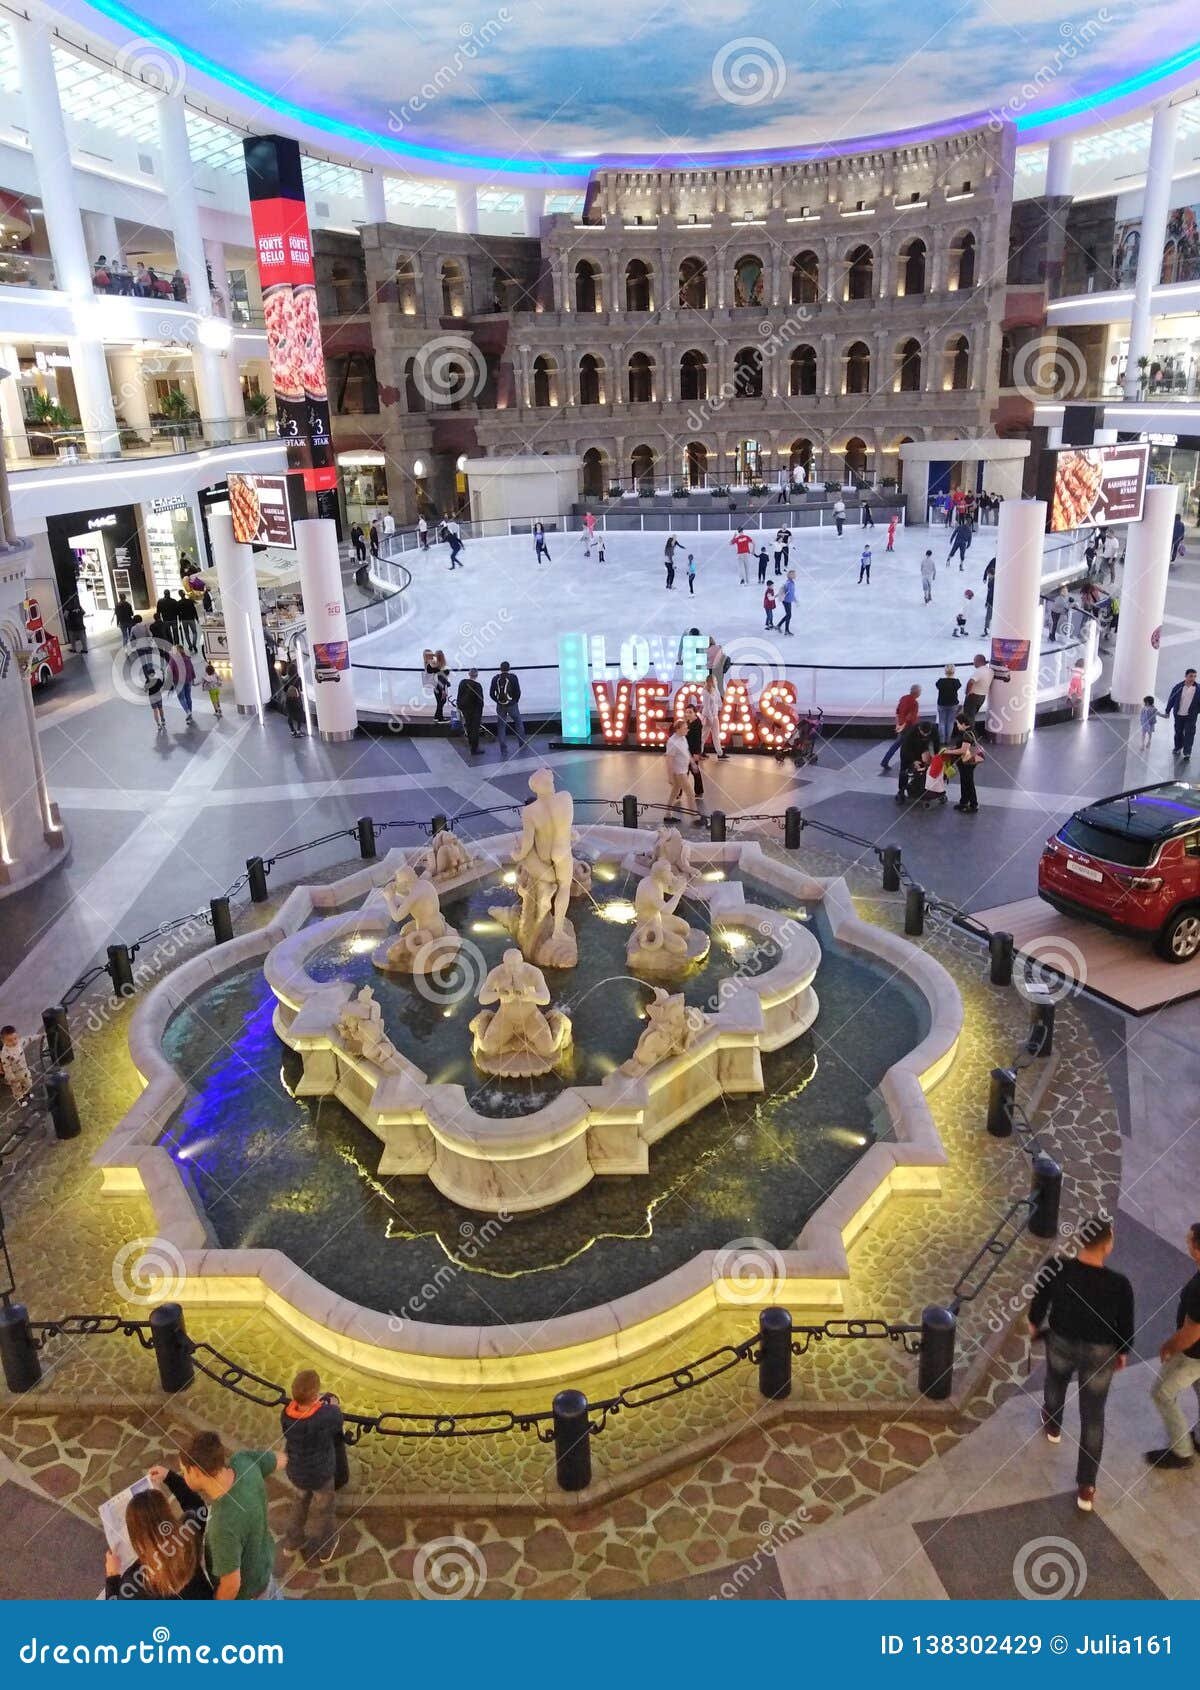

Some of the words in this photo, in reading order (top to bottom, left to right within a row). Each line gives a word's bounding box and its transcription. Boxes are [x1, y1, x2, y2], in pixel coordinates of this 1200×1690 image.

[259, 238, 283, 250] FORTE
[289, 238, 308, 250] FORTE
[260, 250, 285, 262] BELLO
[290, 250, 310, 262] BELLO
[289, 420, 298, 435] 3
[316, 419, 323, 434] 3
[284, 439, 306, 447] ЭТАЖ
[313, 437, 329, 446] ЭТАЖ
[559, 633, 591, 738] I
[591, 635, 710, 681] LOVE
